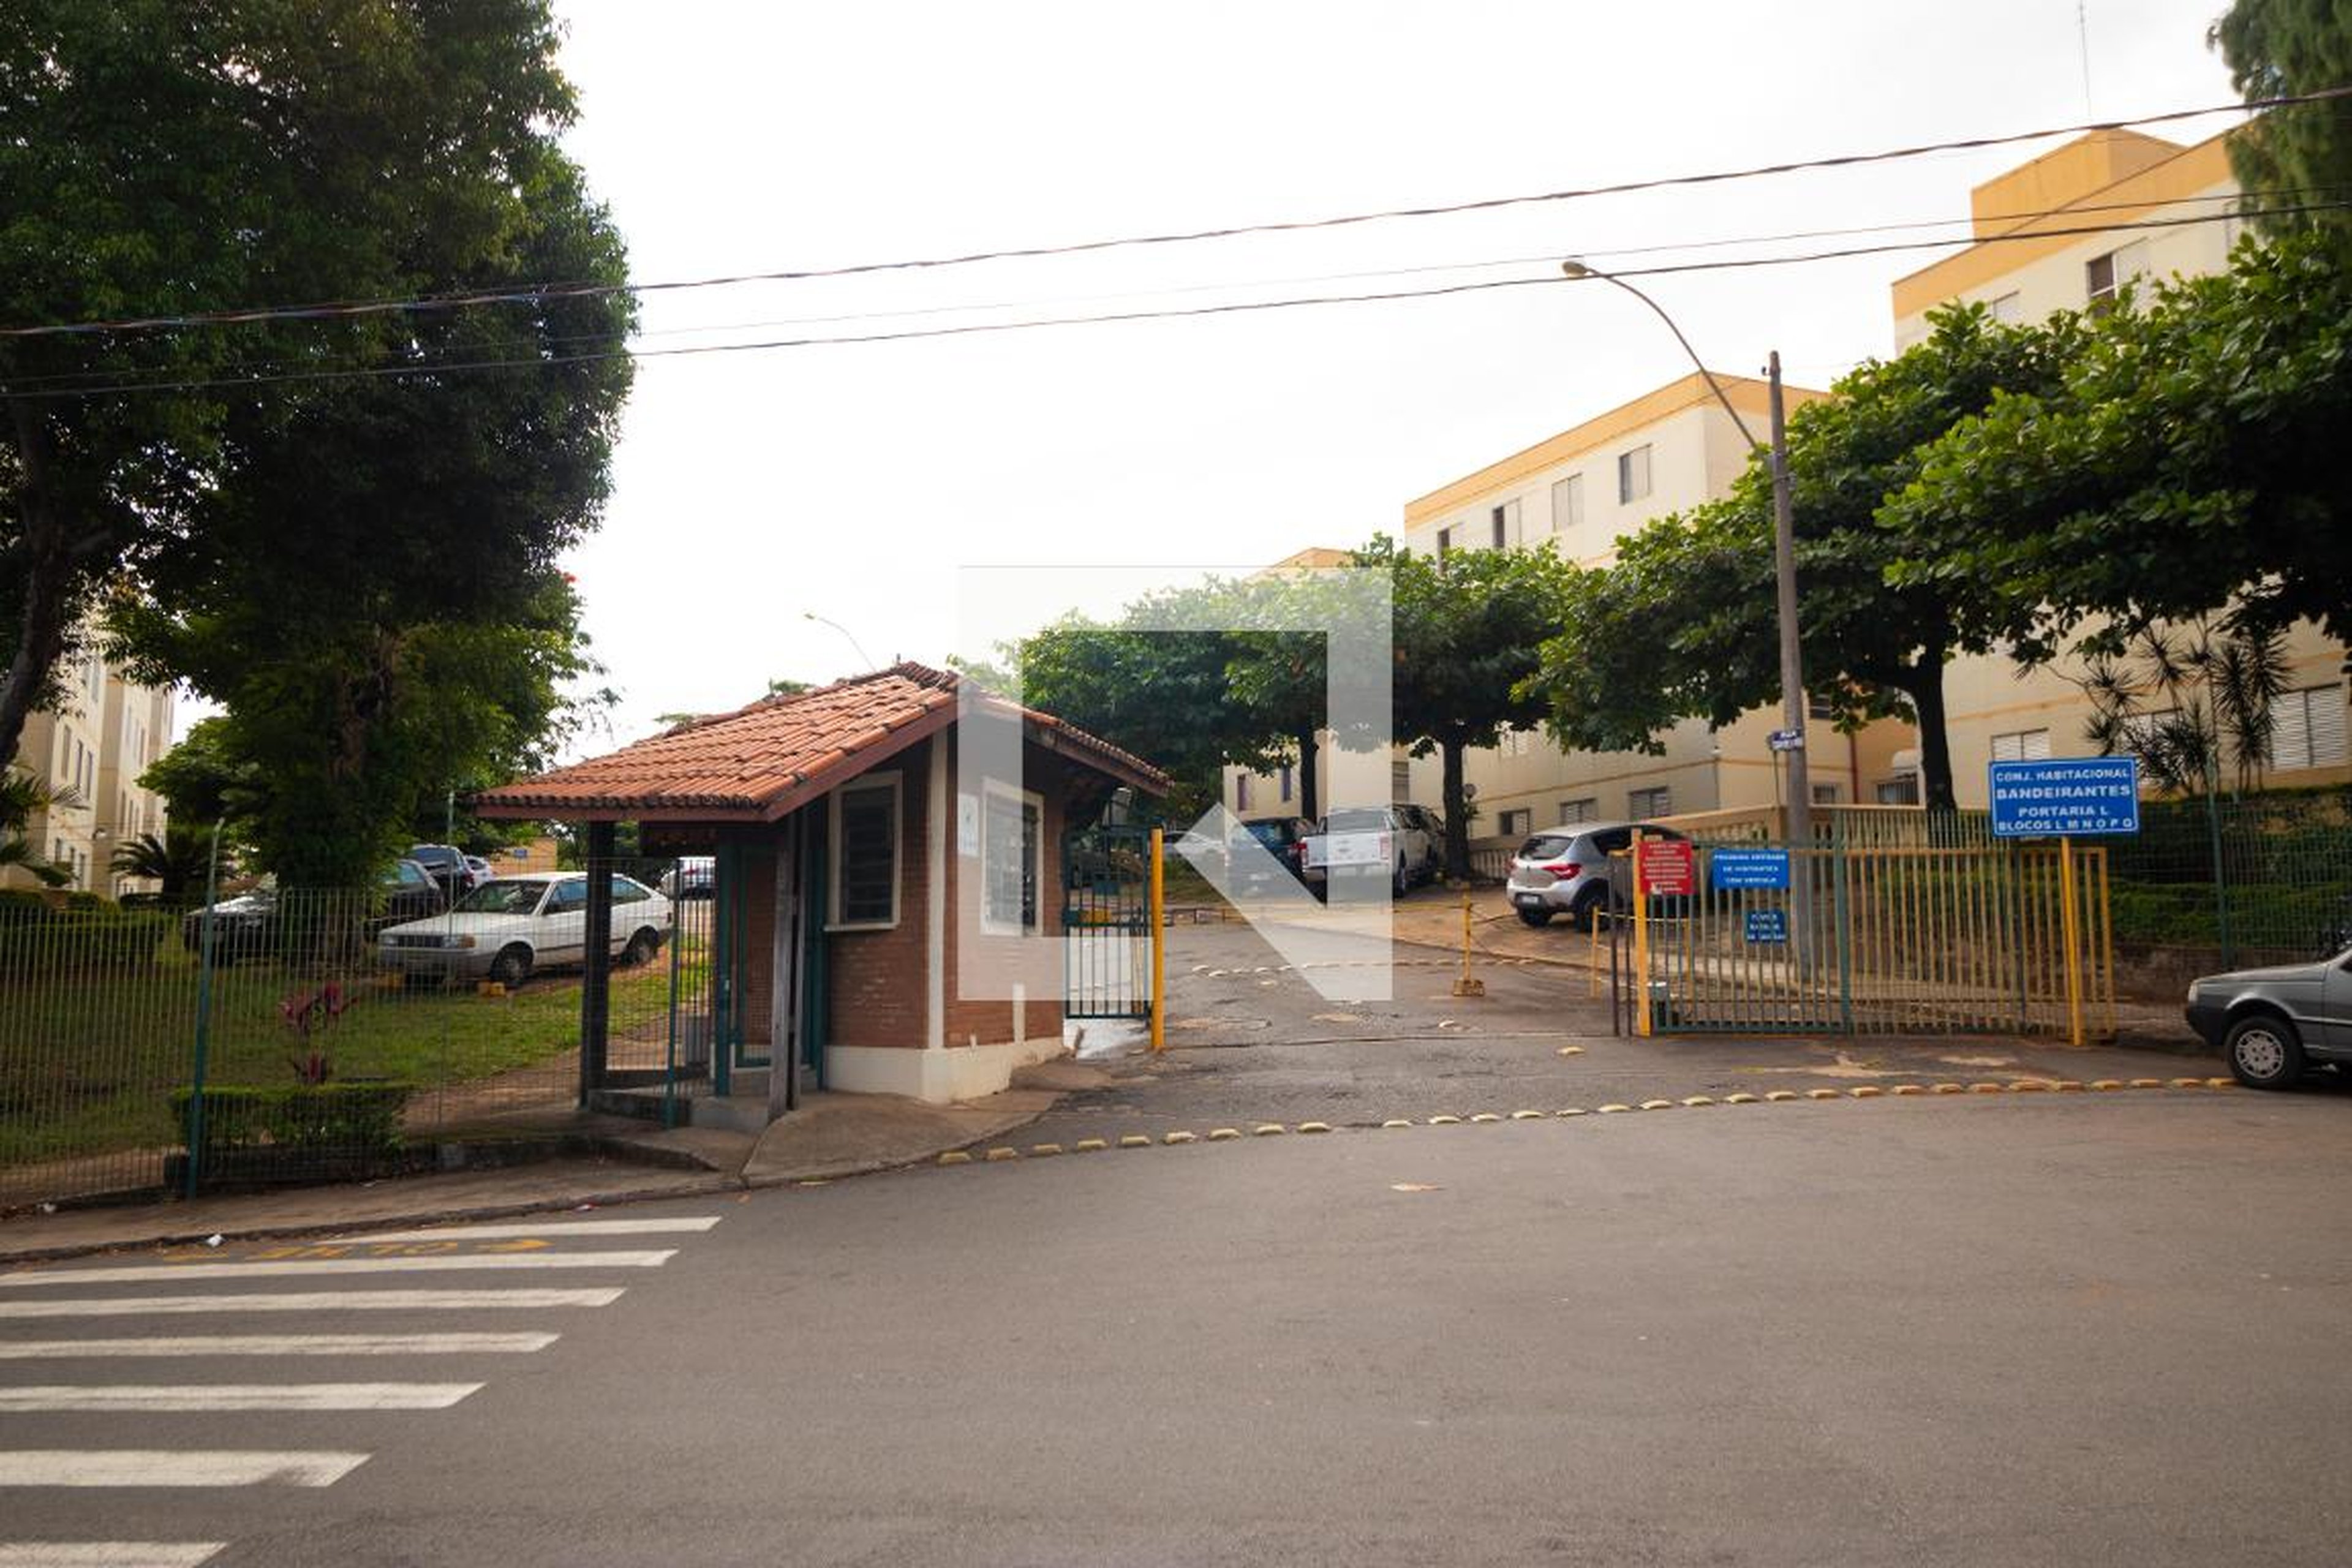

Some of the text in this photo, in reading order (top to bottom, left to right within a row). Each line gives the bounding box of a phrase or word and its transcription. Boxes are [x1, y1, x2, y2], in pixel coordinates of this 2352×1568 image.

[1996, 769, 2130, 782] CONJ. HABITACIONAL
[1997, 785, 2130, 799] BANDEIRANTES
[2019, 805, 2108, 818] PORTARIA L
[1998, 820, 2052, 831] BLOCOS
[2056, 820, 2064, 829] L
[2110, 818, 2119, 828] P
